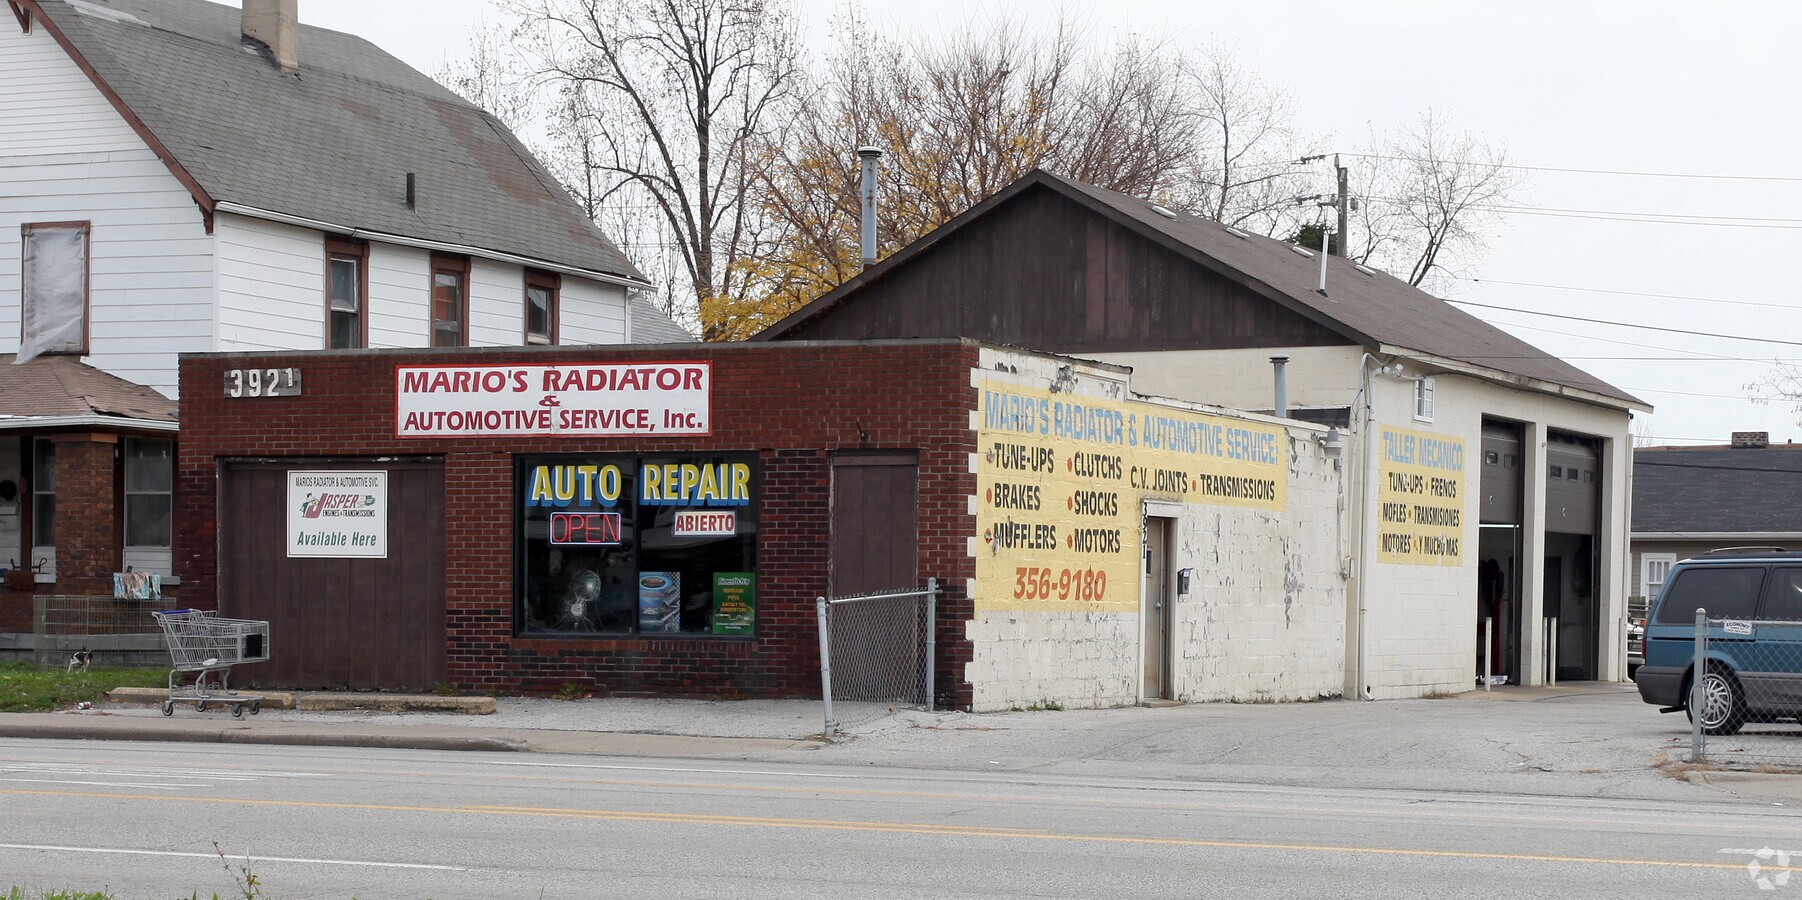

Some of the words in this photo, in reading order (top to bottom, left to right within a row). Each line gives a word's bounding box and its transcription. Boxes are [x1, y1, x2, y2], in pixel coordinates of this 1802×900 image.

[231, 368, 293, 397] 3921
[403, 369, 529, 394] MARIO'S
[542, 368, 703, 392] RADIATOR
[539, 395, 561, 407] &
[403, 410, 550, 431] AUTOMOTIVE
[560, 409, 655, 432] SERVICE,
[664, 409, 704, 429] Inc.
[985, 391, 1048, 435] MARIO'S
[1054, 402, 1124, 446] RADIATOR
[1128, 413, 1138, 447] &
[1143, 415, 1223, 457] AUTOMOTIVE
[994, 443, 1055, 474] TUNE-UPS
[1384, 431, 1416, 464] TALLER
[1419, 437, 1463, 472] MECANICO
[1074, 452, 1122, 480] CLUTCHS
[313, 477, 335, 487] RADIATOR
[340, 477, 368, 487] AUTOMOTIVE
[529, 464, 621, 507] AUTO
[641, 463, 750, 506] REPAIR
[1130, 466, 1149, 490] C.V.
[1153, 468, 1188, 494] JOINTS
[1200, 474, 1275, 501] TRANSMISSIONS
[1389, 472, 1423, 494] TUNE-UPS
[1431, 477, 1457, 498] FRENOS
[304, 493, 360, 518] JASPER
[994, 483, 1041, 511] BRAKES
[1074, 490, 1118, 517] SHOCKS
[675, 514, 735, 531] ABIERTO
[1383, 502, 1407, 523] MOFLES
[1414, 505, 1460, 527] TRANSMISIONES
[297, 531, 347, 546] Available
[352, 532, 377, 546] Here
[551, 514, 620, 543] OPEN
[993, 522, 1057, 550] MUFFLERS
[1074, 528, 1121, 554] MOTORS
[1382, 533, 1411, 554] MOTORES
[1446, 538, 1458, 556] MAS
[1013, 567, 1106, 601] 356-9180
